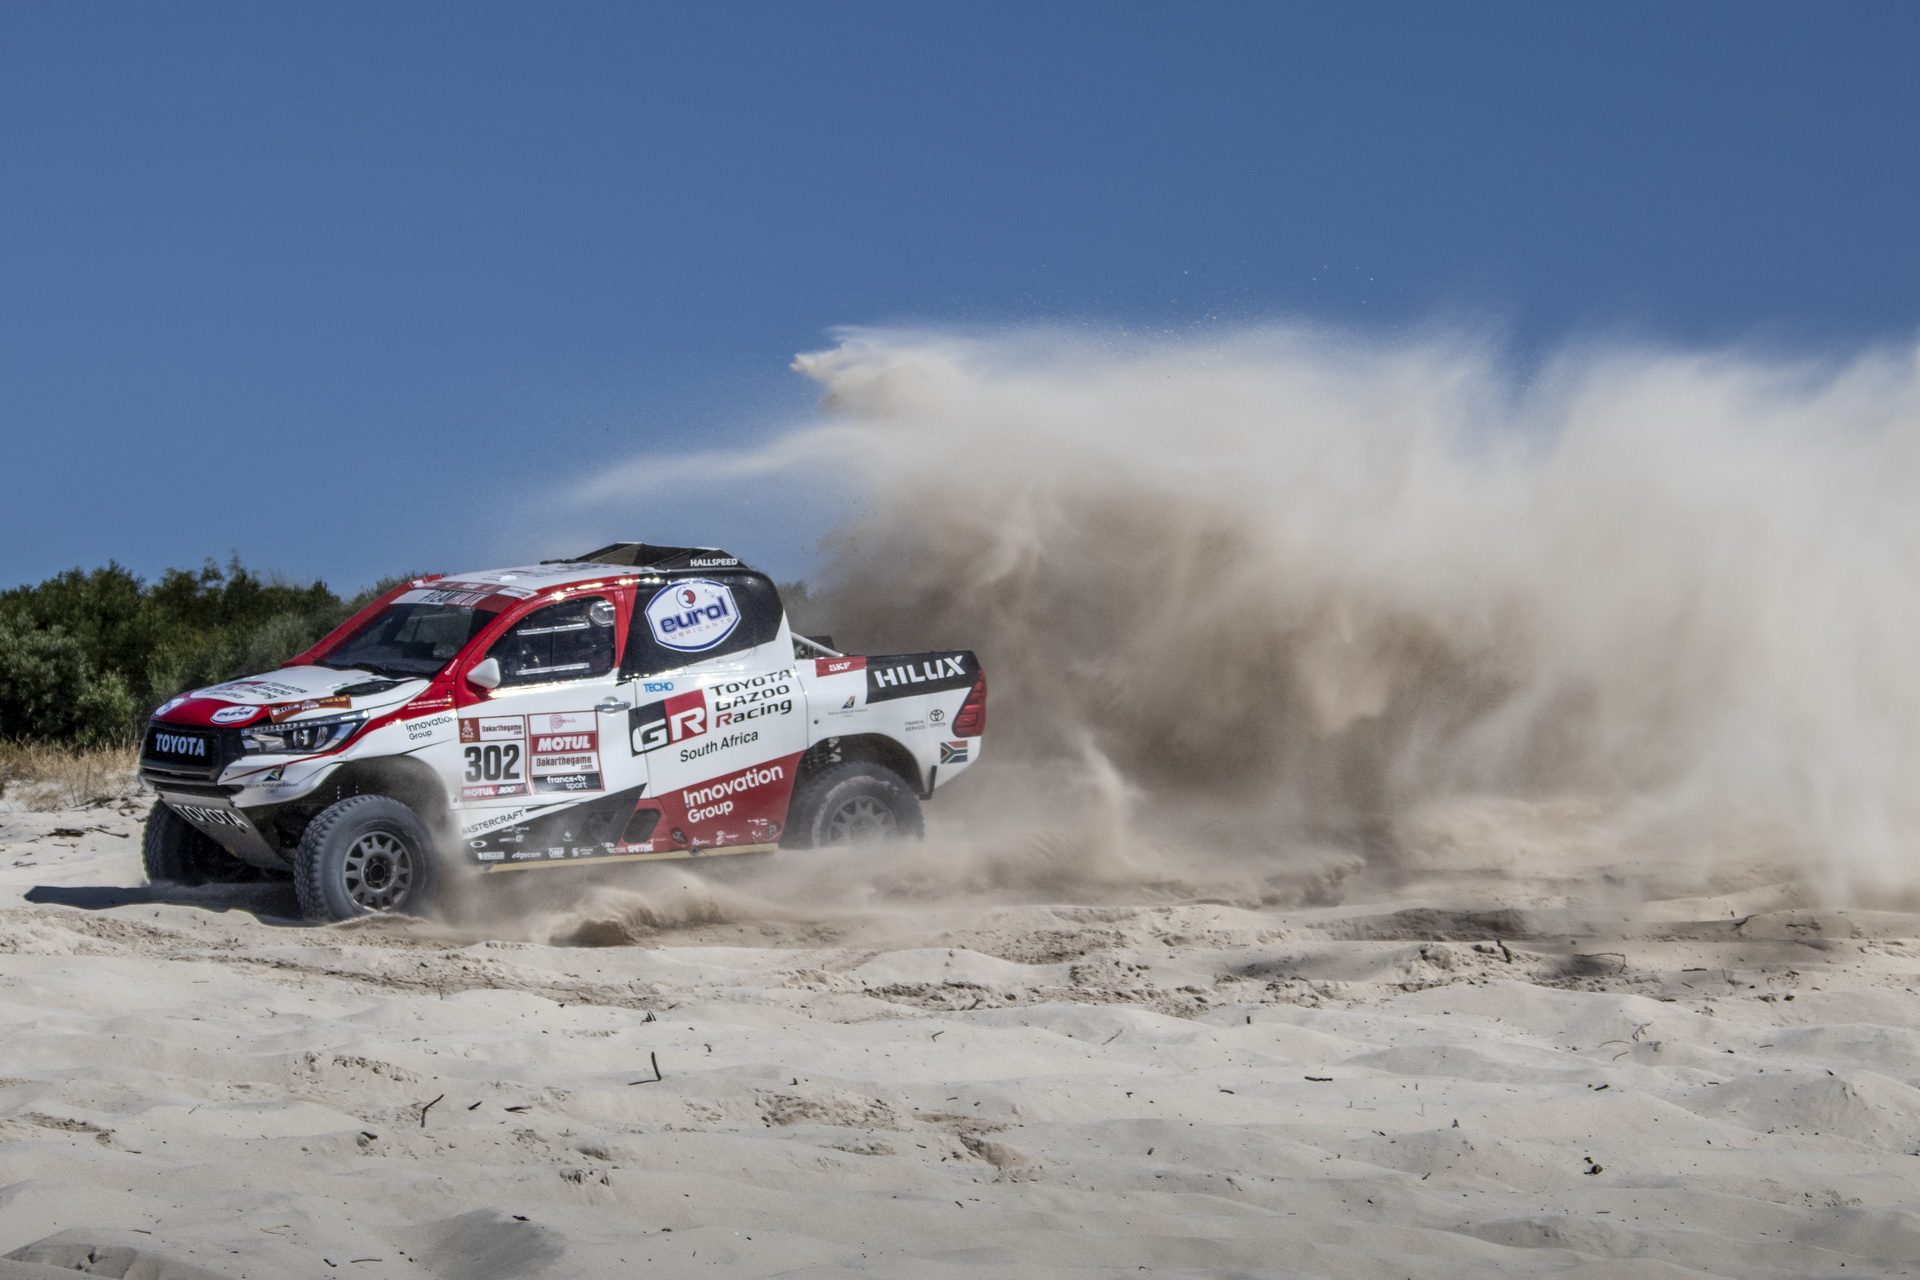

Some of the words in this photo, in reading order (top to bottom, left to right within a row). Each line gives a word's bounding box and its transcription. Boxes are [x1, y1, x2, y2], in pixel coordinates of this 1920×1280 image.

[690, 558, 738, 567] HALLSPEED
[660, 595, 731, 635] eurol
[664, 617, 733, 641] LUBRICANTS
[828, 662, 852, 672] SKF
[873, 655, 966, 688] HILUX
[643, 682, 674, 693] TECHO
[709, 669, 793, 697] TOYOTA
[715, 684, 790, 712] GAZOO
[405, 714, 457, 732] Innovation
[715, 699, 792, 728] Racing
[408, 730, 433, 741] Group
[481, 724, 522, 733] Dakarthegame
[632, 707, 706, 753] GR
[155, 733, 206, 757] TOYOTA
[537, 735, 591, 752] MOTUL
[680, 741, 718, 762] South
[720, 731, 759, 750] Africa
[464, 744, 520, 783] 302
[536, 756, 592, 768] Dakarthegame
[462, 787, 495, 798] MOTUL
[565, 781, 588, 791] sport
[683, 766, 784, 808] Innovation
[172, 803, 250, 829] TOYOTA
[687, 800, 734, 823] Group
